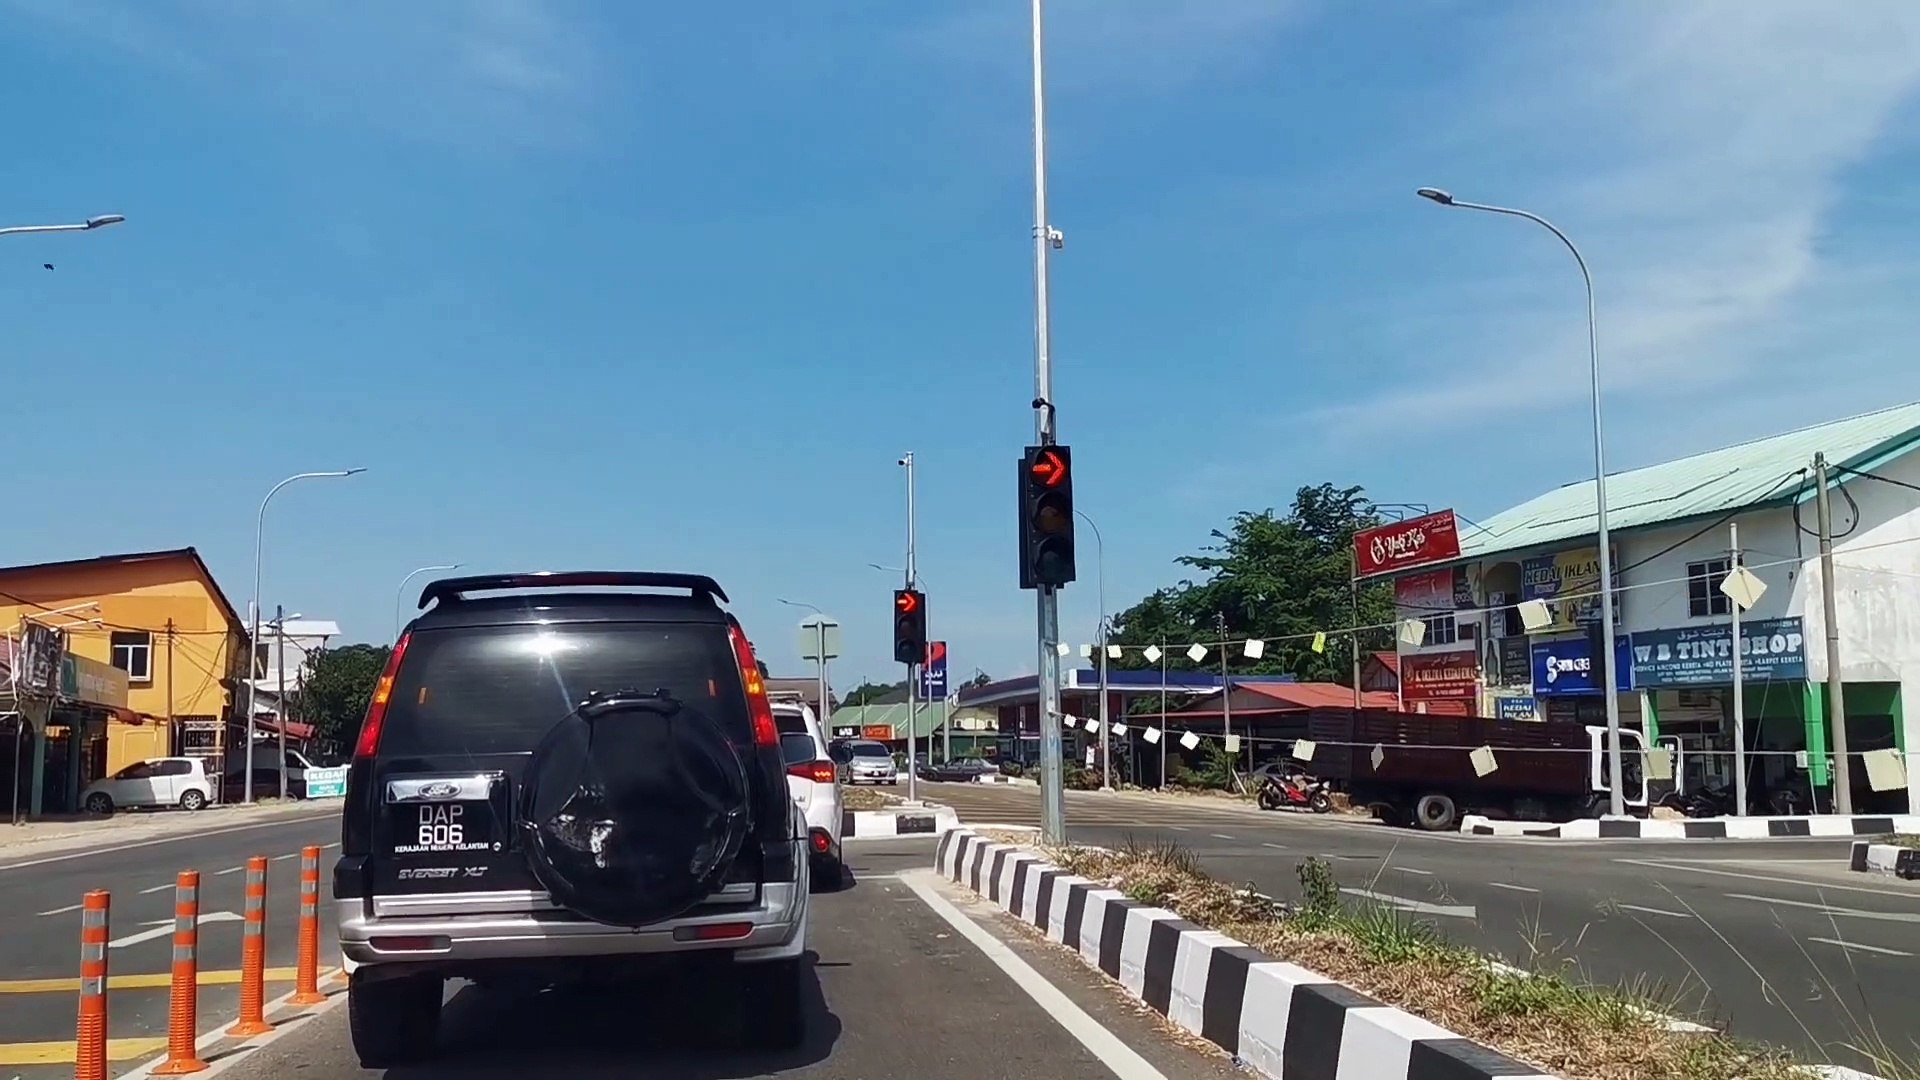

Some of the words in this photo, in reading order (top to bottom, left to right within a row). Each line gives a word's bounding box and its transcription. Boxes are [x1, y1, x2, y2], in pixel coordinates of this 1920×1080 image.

[1524, 564, 1560, 585] KEDAI
[1564, 560, 1601, 578] IKLAN
[1634, 645, 1652, 663] W
[1657, 643, 1671, 661] B
[1677, 638, 1731, 660] TINT
[1740, 633, 1803, 655] SHOP
[1504, 711, 1533, 719] IKLAN
[419, 804, 464, 824] DAP
[418, 825, 463, 845] 606
[394, 845, 429, 853] KERAJAAN
[430, 844, 454, 852] NEGERI
[455, 842, 489, 851] KELANTAN
[398, 867, 459, 879] EVEREST
[463, 866, 489, 877] XLT
